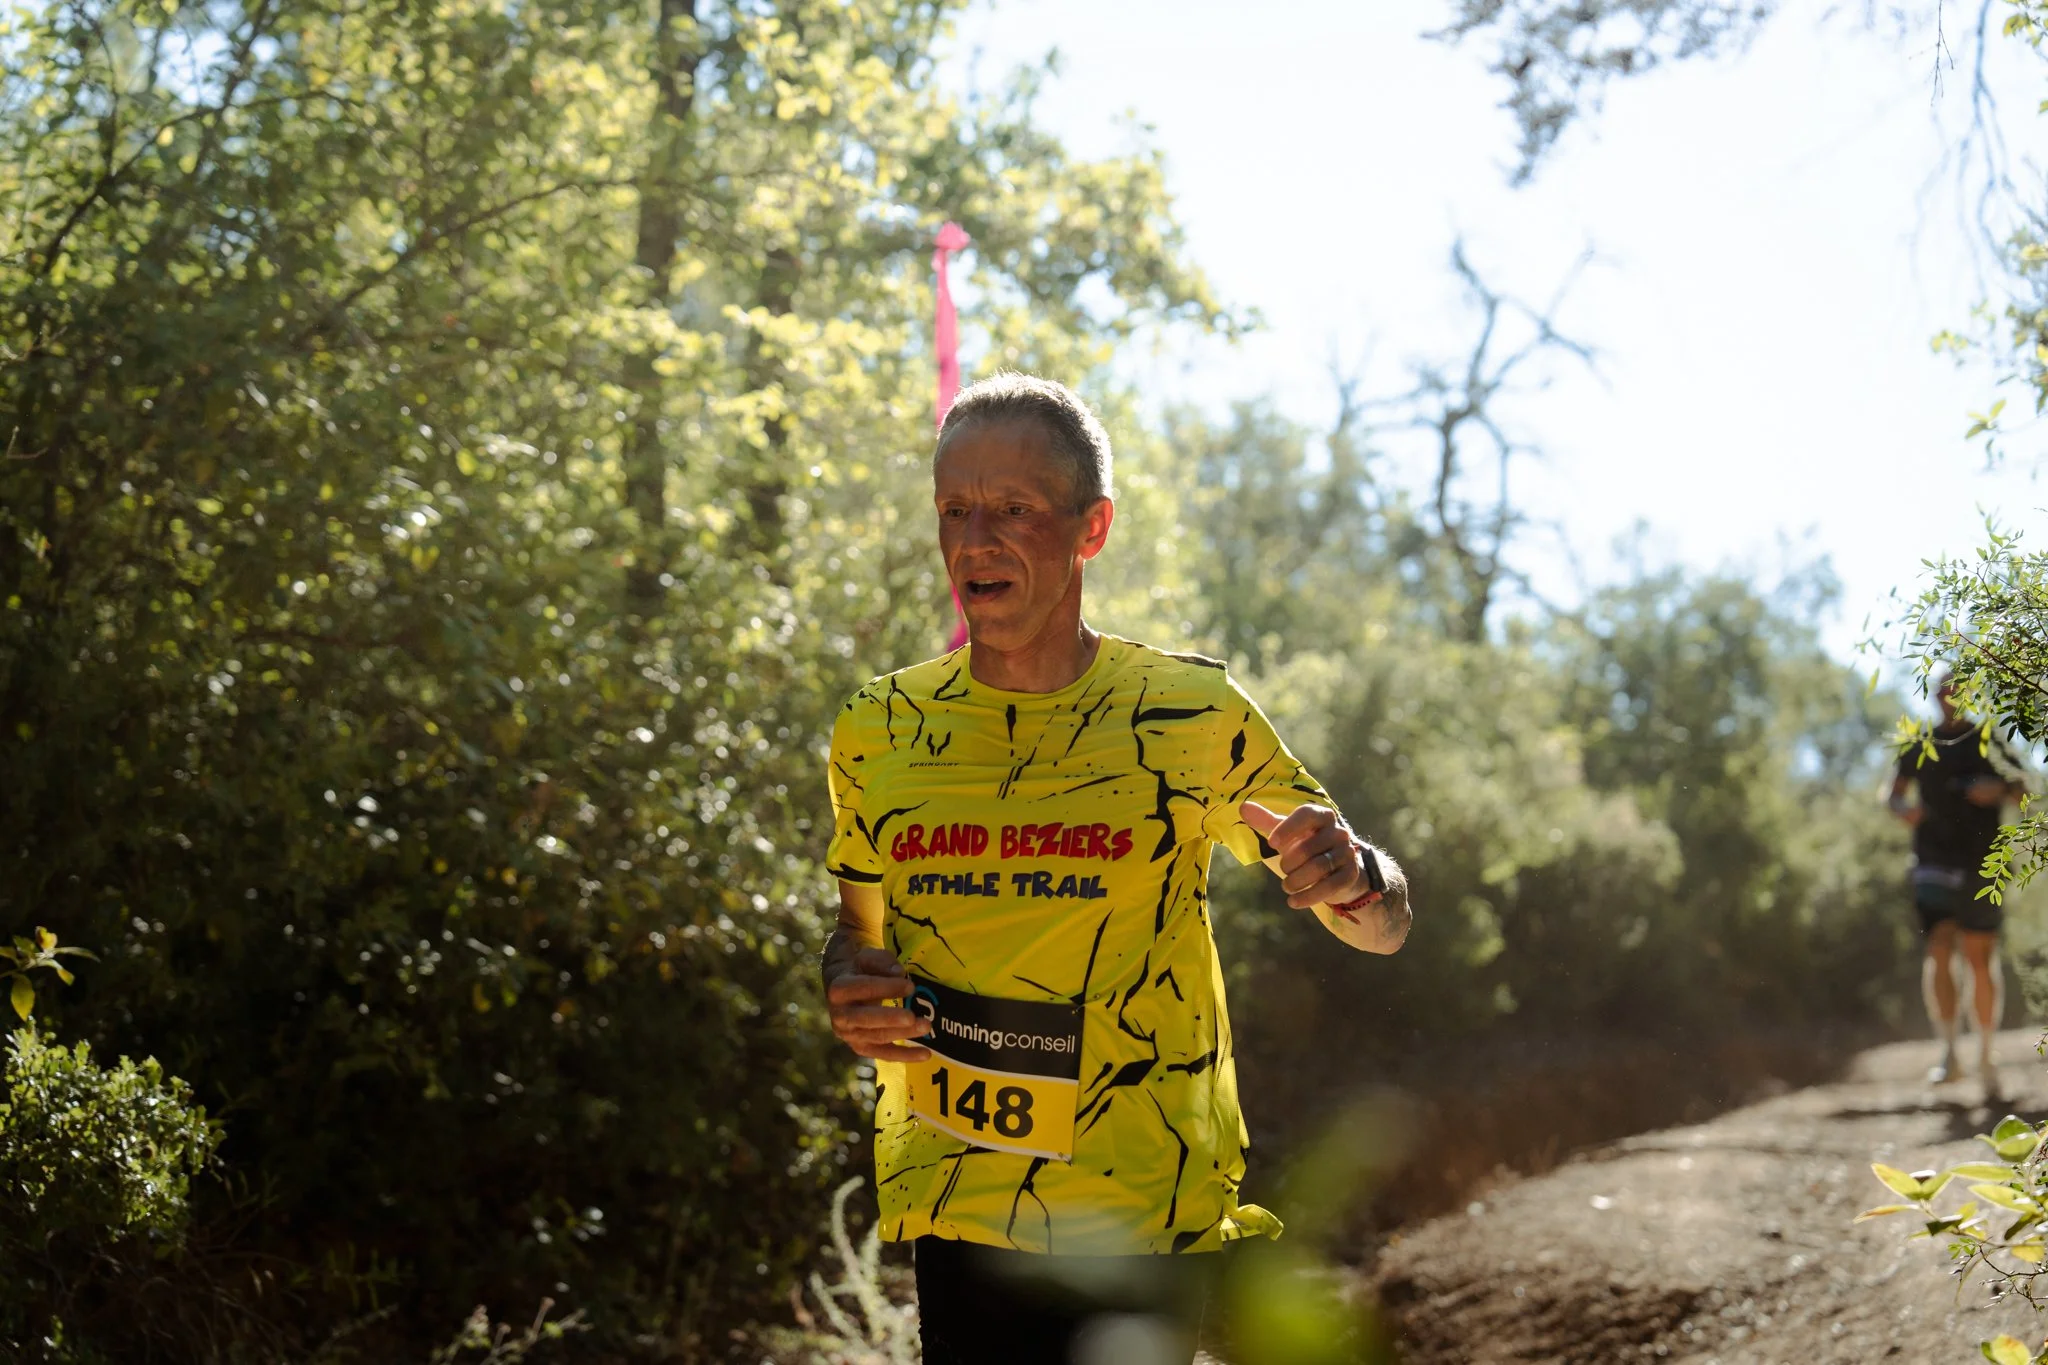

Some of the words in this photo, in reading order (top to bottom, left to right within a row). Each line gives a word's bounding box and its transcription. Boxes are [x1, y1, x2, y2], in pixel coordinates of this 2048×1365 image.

[891, 823, 989, 862] GRAND
[1001, 822, 1133, 862] BEZIERS
[907, 872, 1000, 897] ATHLE
[1011, 870, 1107, 899] TRAIL
[941, 1016, 1075, 1053] runningconseil
[931, 1066, 1034, 1139] 148
